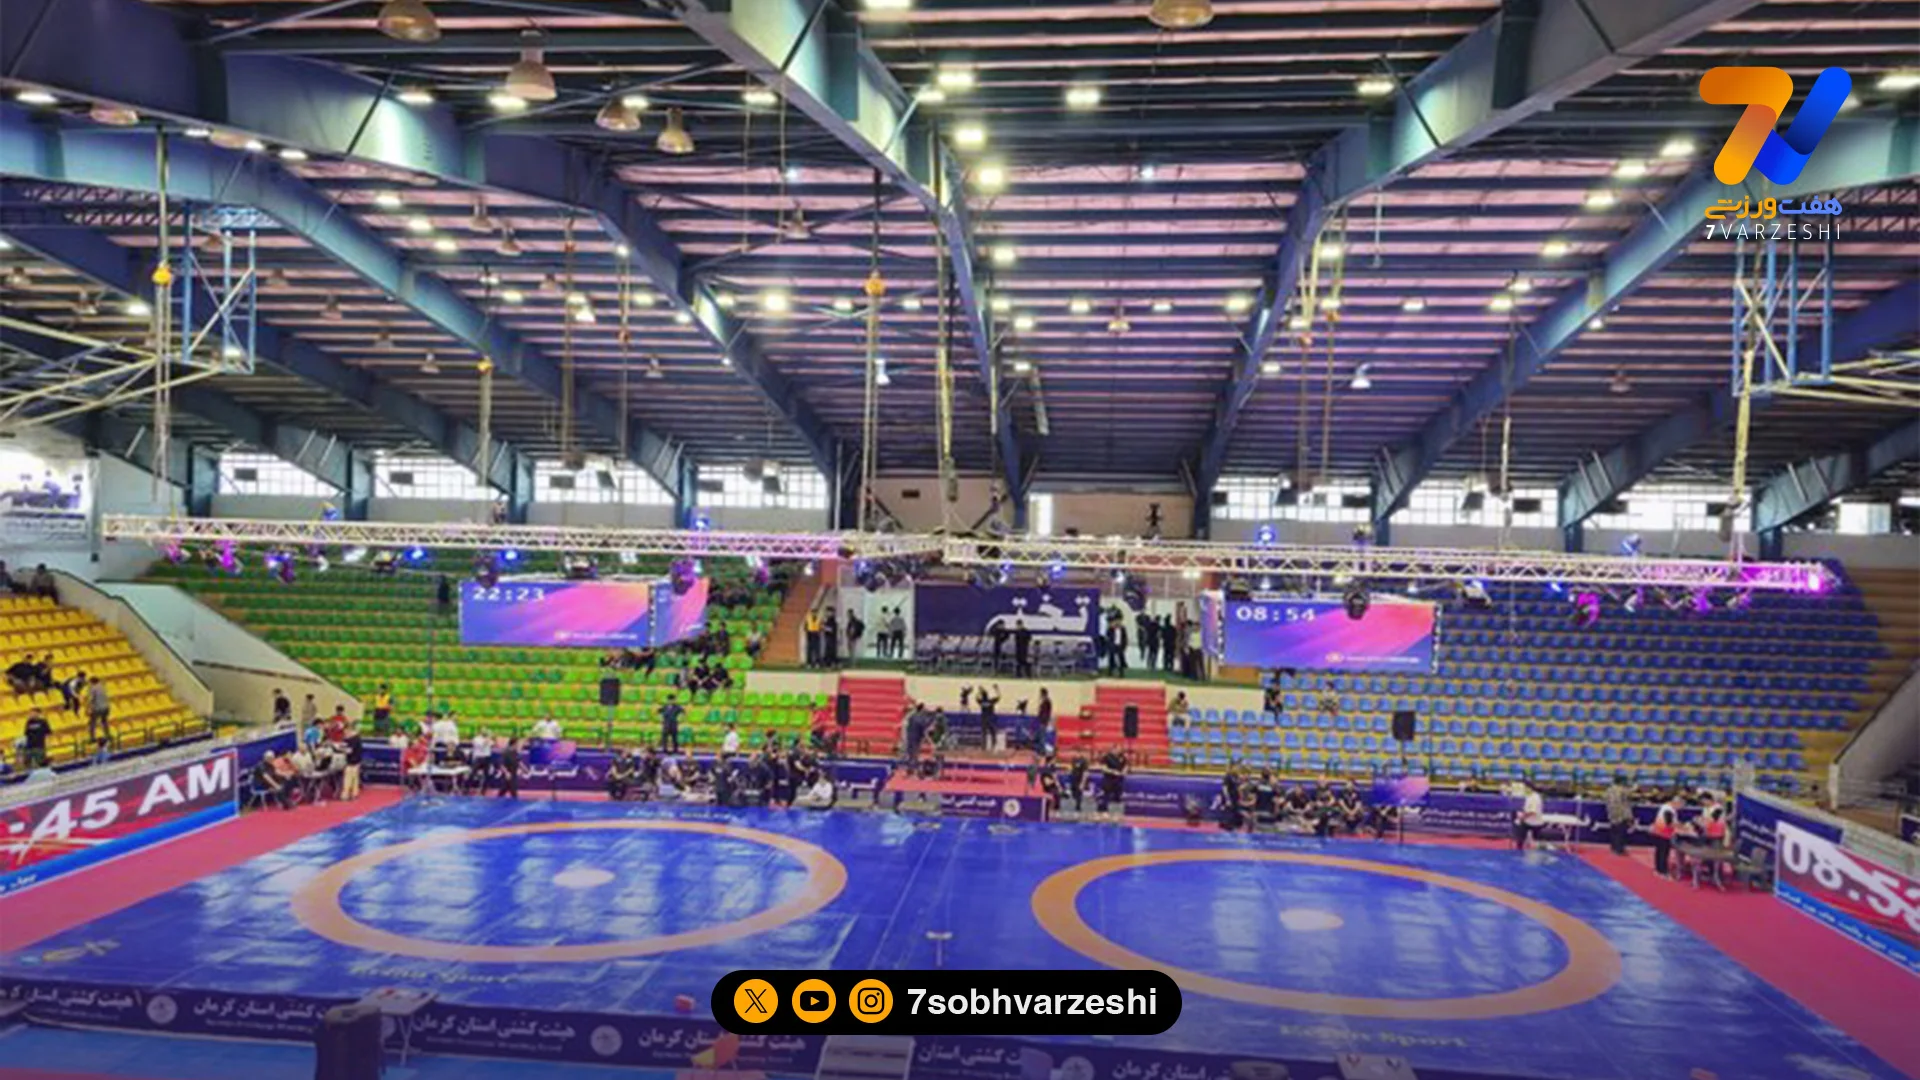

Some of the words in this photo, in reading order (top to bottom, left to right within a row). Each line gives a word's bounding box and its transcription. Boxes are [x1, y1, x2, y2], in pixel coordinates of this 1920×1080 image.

[472, 587, 544, 601] 22:23
[1236, 606, 1316, 621] 08:54
[137, 757, 231, 817] AM
